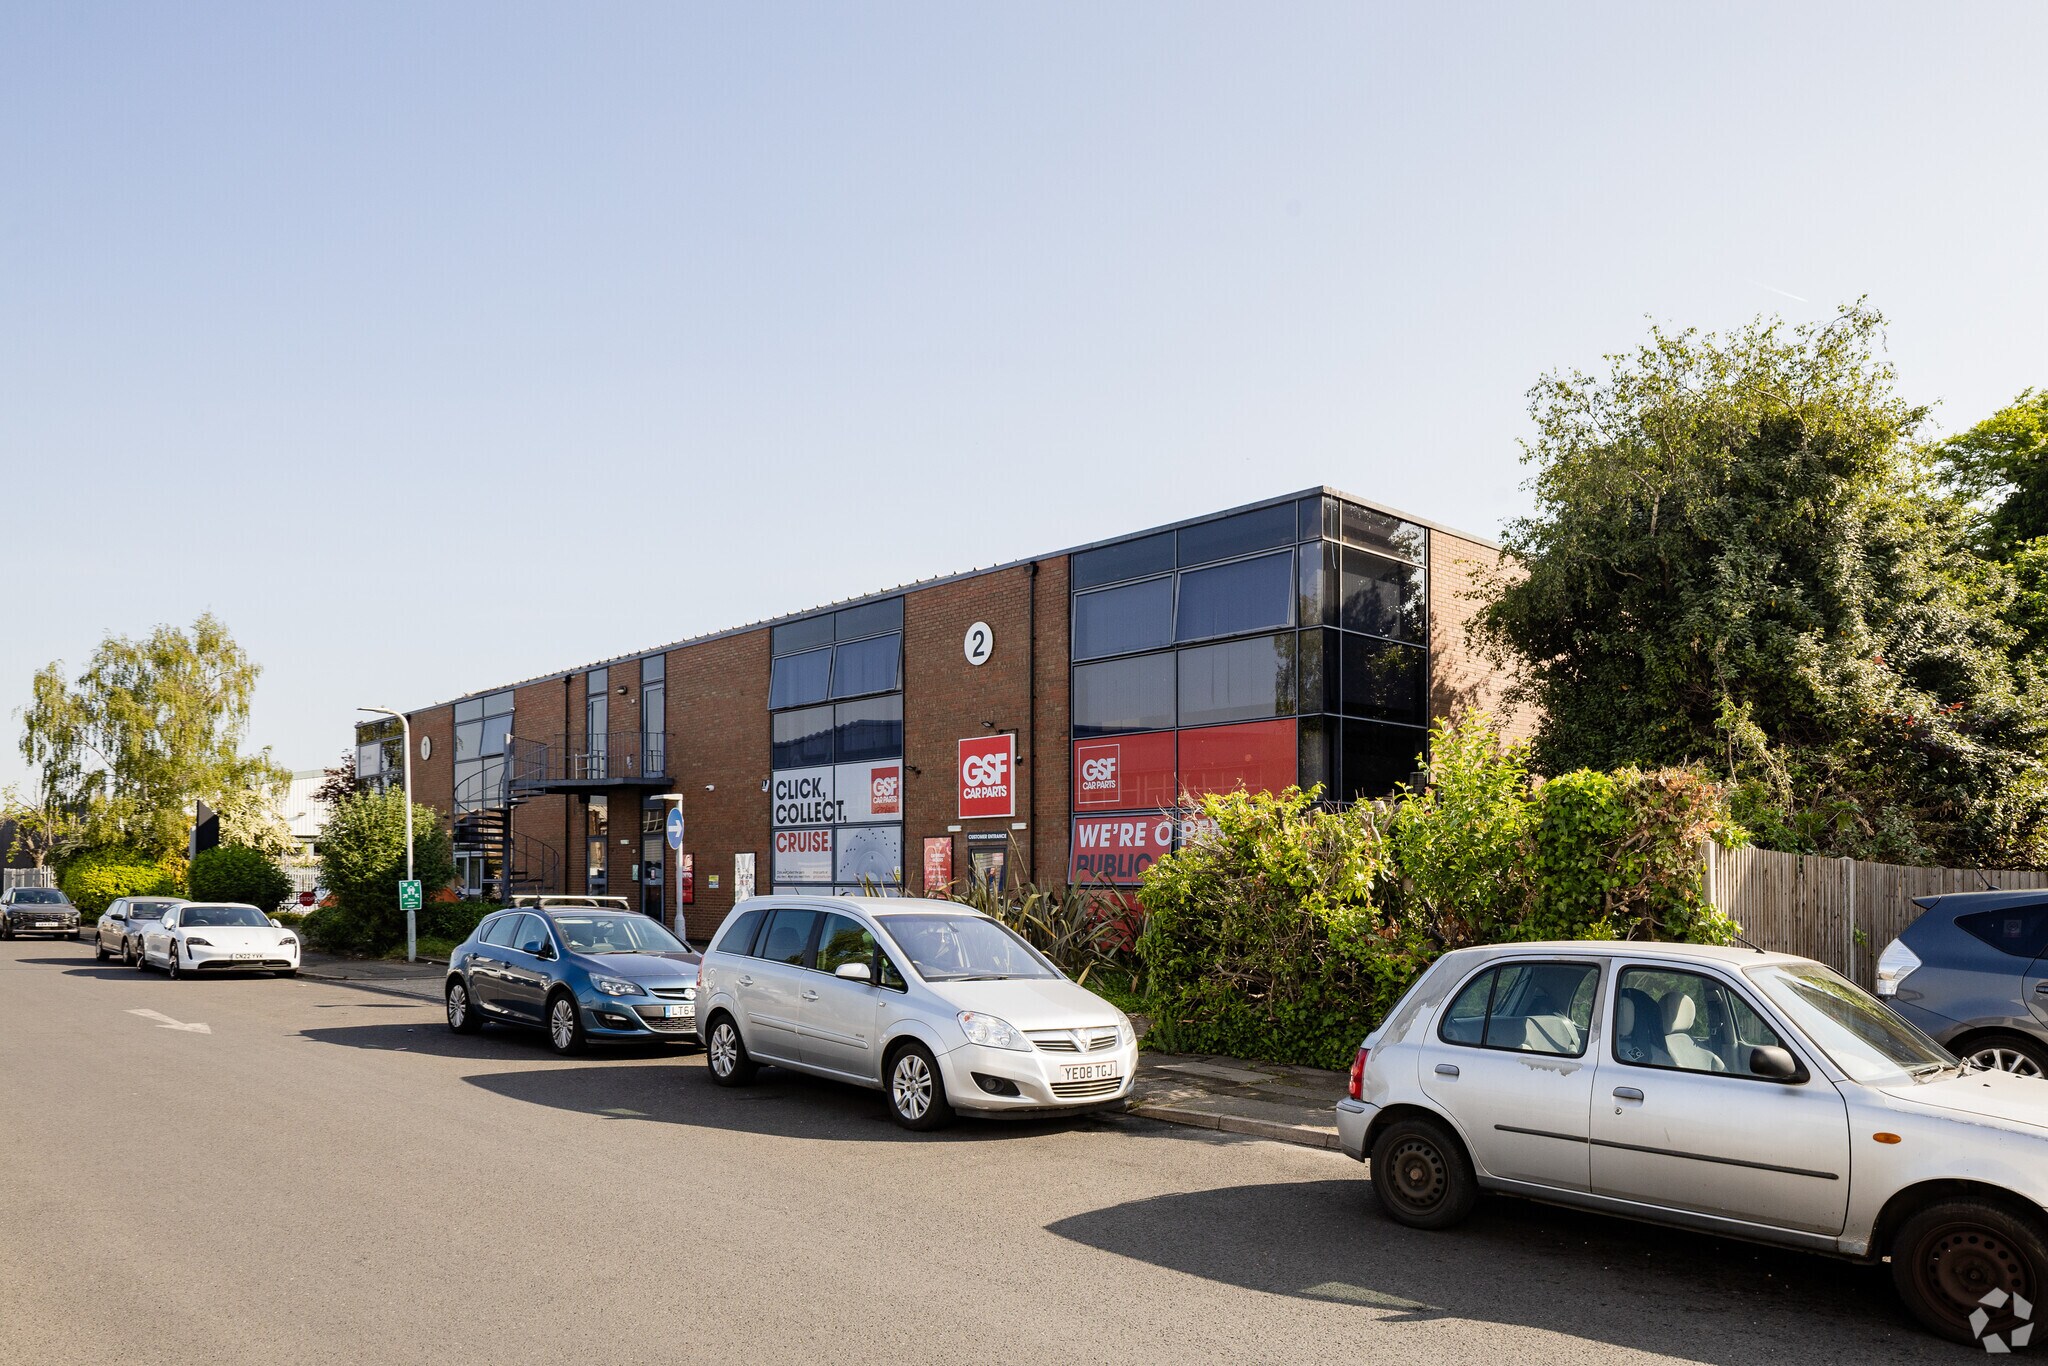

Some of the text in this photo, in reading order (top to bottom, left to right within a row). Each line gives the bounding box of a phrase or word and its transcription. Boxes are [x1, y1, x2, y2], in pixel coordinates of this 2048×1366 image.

[972, 630, 985, 658] 2
[963, 752, 1007, 787] GSF
[1082, 757, 1116, 781] GSF
[776, 777, 826, 801] CLICK,
[872, 777, 897, 796] GSF
[963, 785, 1007, 799] CAR PARTS
[1082, 780, 1116, 790] CAR PARTS
[776, 800, 847, 824] COLLECT,
[776, 831, 832, 853] CRUISE.
[1078, 822, 1147, 848] WE'RE
[1076, 853, 1152, 878] PUBLIC
[672, 1005, 695, 1016] LT64
[1065, 1064, 1113, 1080] YE08 TGJ
